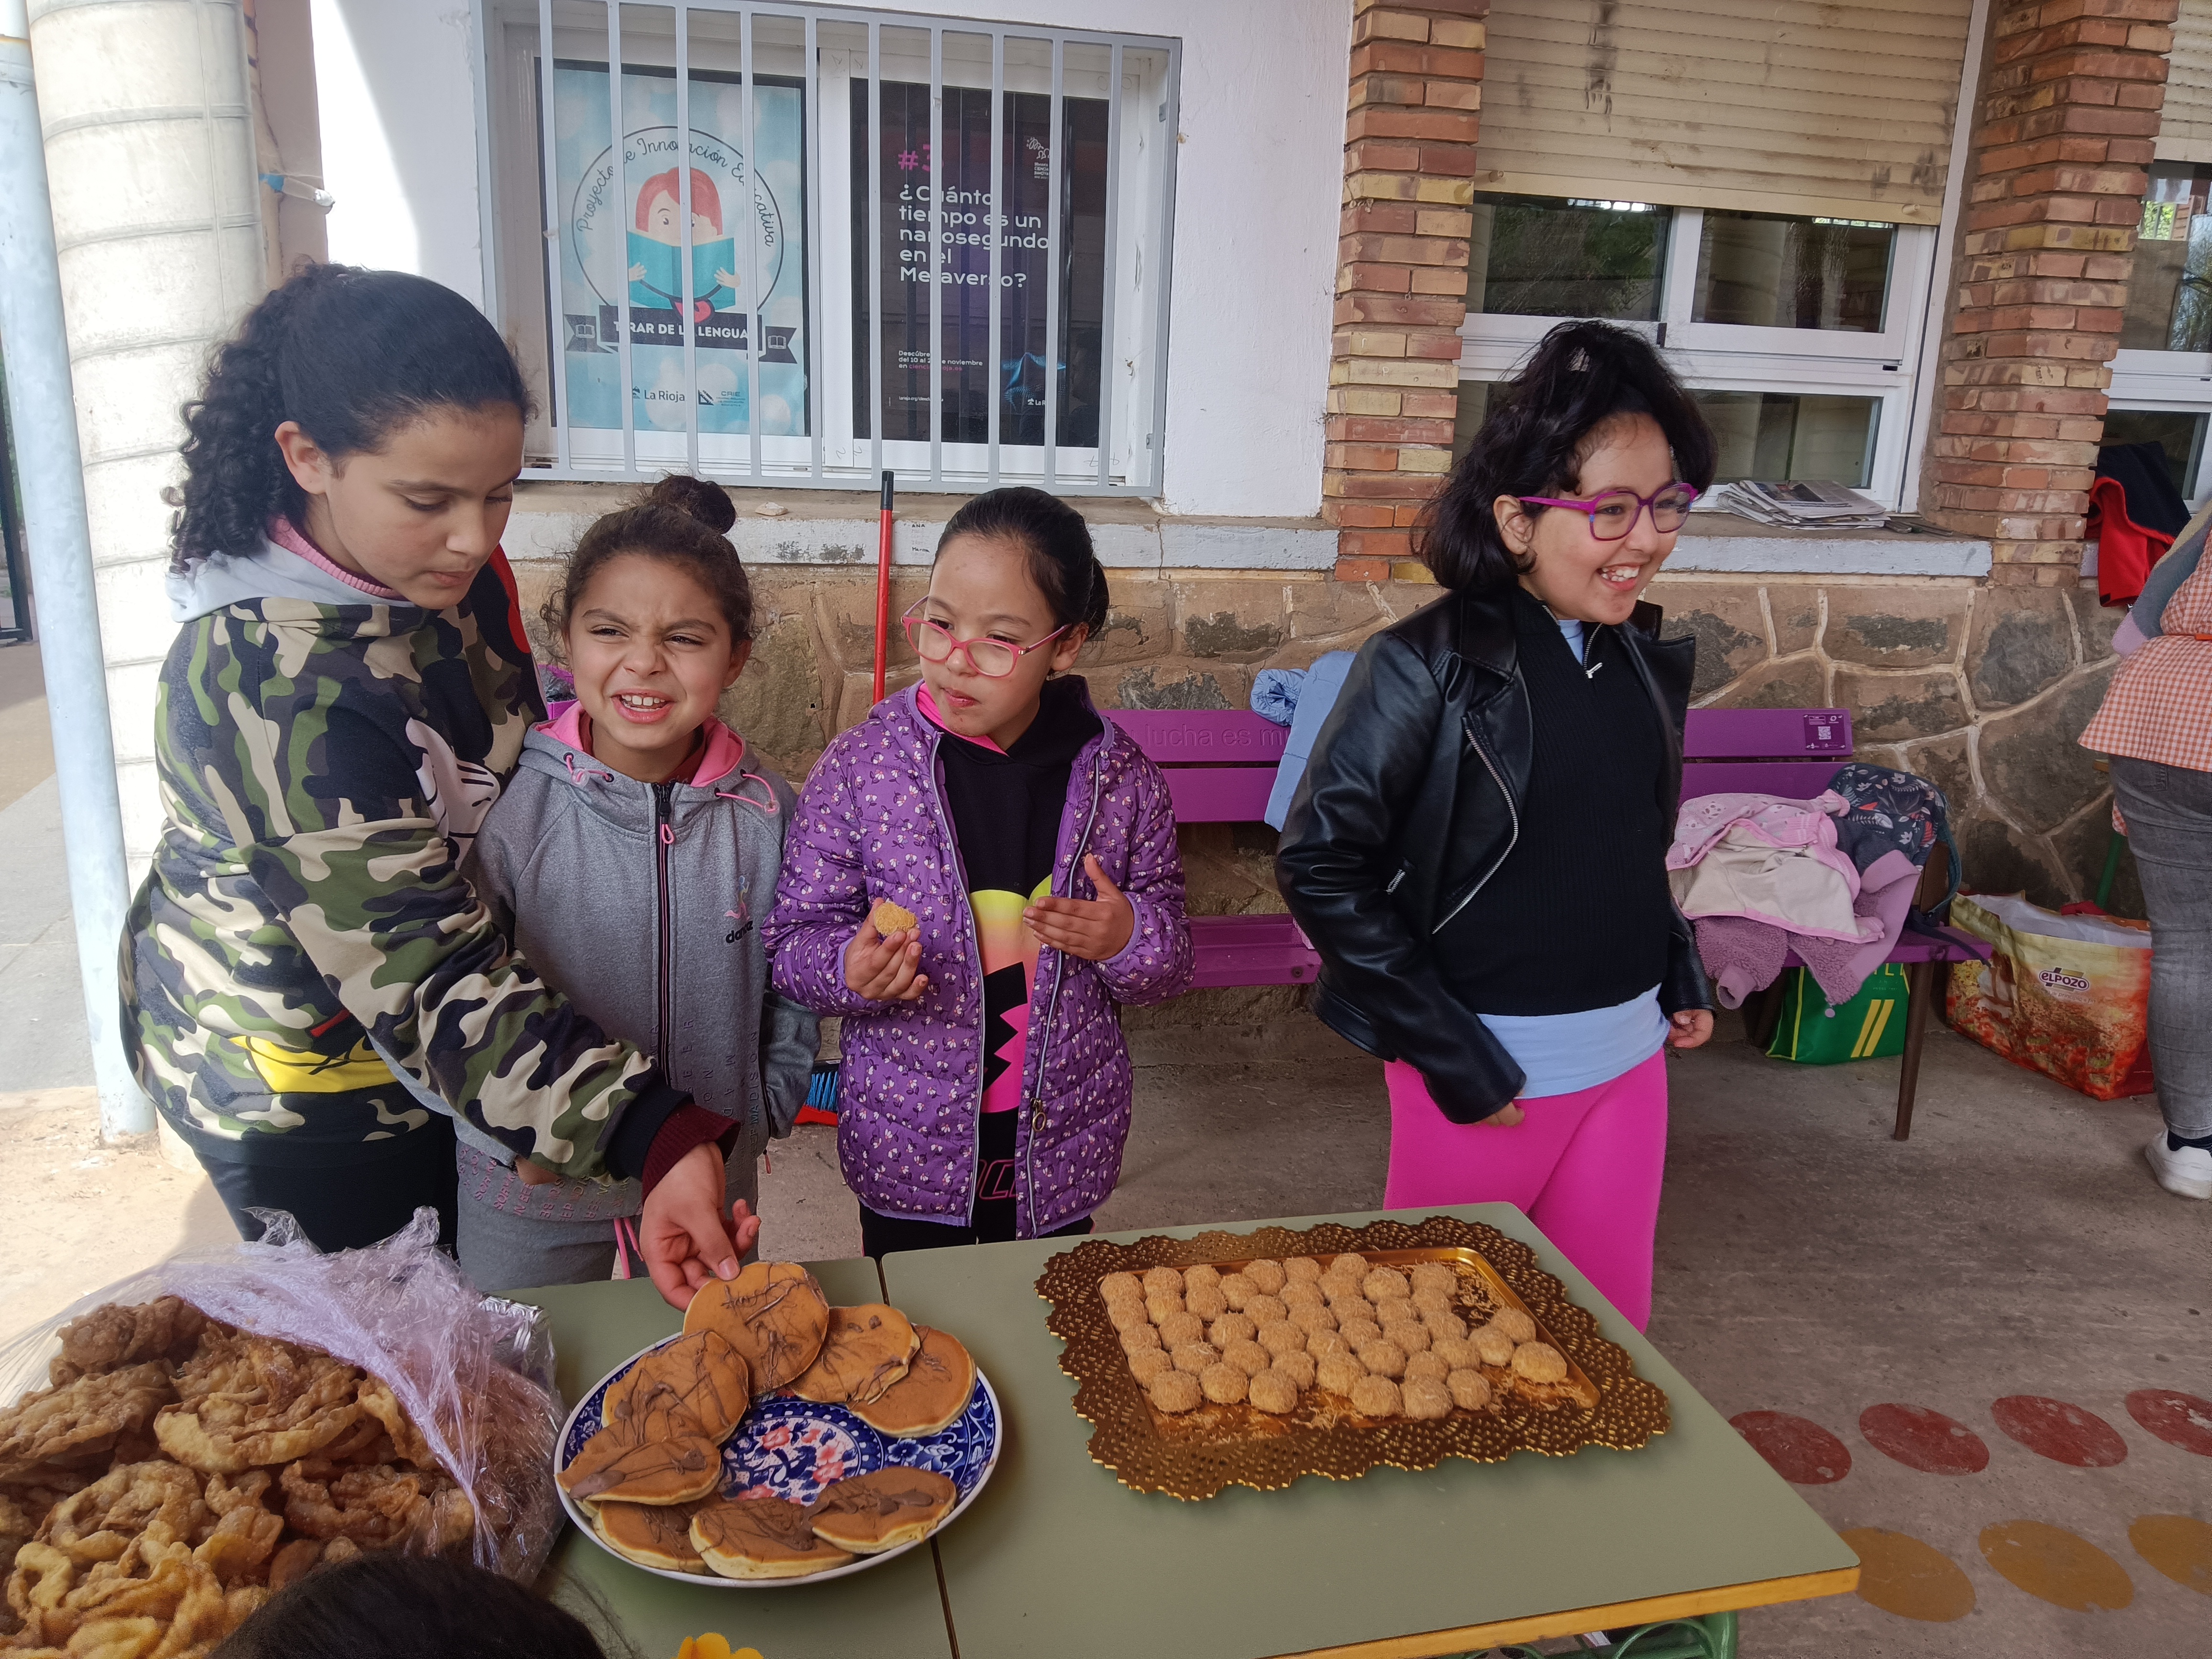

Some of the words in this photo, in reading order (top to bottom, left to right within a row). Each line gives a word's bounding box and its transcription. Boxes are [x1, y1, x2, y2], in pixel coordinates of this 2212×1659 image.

[576, 166, 613, 232] Proyecto
[1015, 215, 1041, 229] un
[900, 249, 927, 262] en
[900, 266, 1027, 288] Meavero?
[658, 324, 675, 334] DE
[698, 326, 749, 339] LENGUA
[644, 389, 656, 400] La
[659, 390, 686, 403] Rioja
[1145, 724, 1213, 746] lucha
[1222, 729, 1251, 746] es
